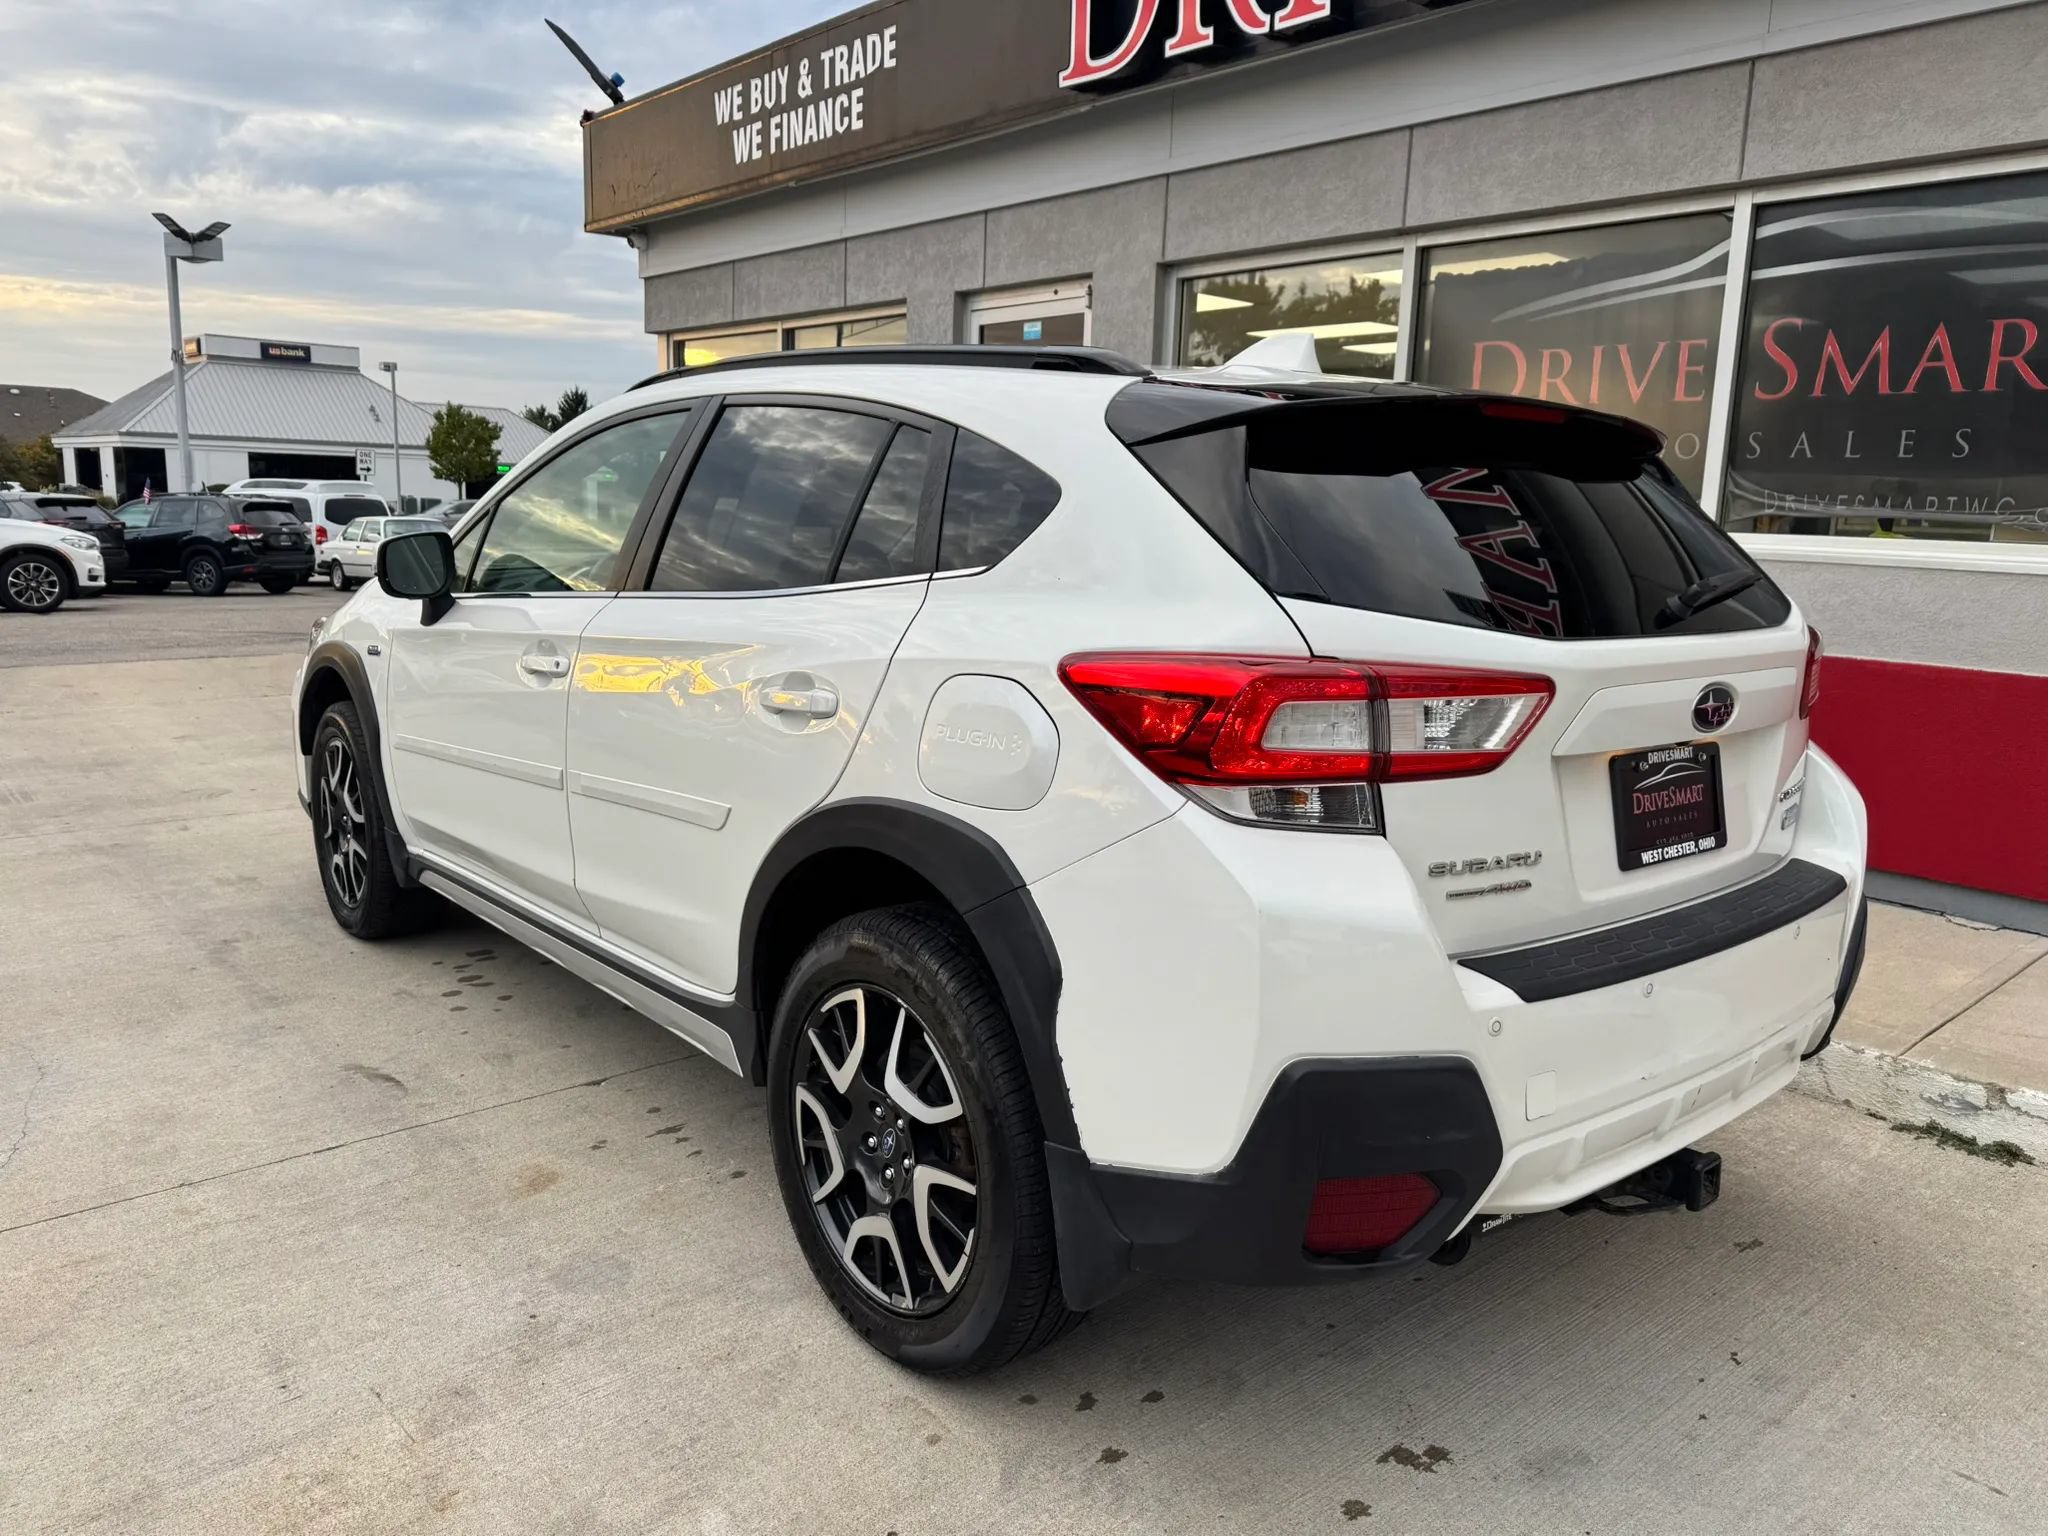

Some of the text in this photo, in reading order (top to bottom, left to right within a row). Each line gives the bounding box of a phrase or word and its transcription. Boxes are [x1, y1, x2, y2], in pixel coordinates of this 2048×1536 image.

[714, 24, 897, 125] WE BUY & TRADE
[732, 87, 864, 165] WE FINANCE
[1471, 316, 2048, 405] DRIVE SMAR
[1746, 428, 1972, 459] SALES
[1648, 746, 1694, 764] DRIVESMART
[1428, 849, 1542, 877] SUBARU
[1641, 847, 1662, 864] WEST
[1663, 840, 1698, 859] CHESTER,
[1698, 836, 1716, 853] OHIO
